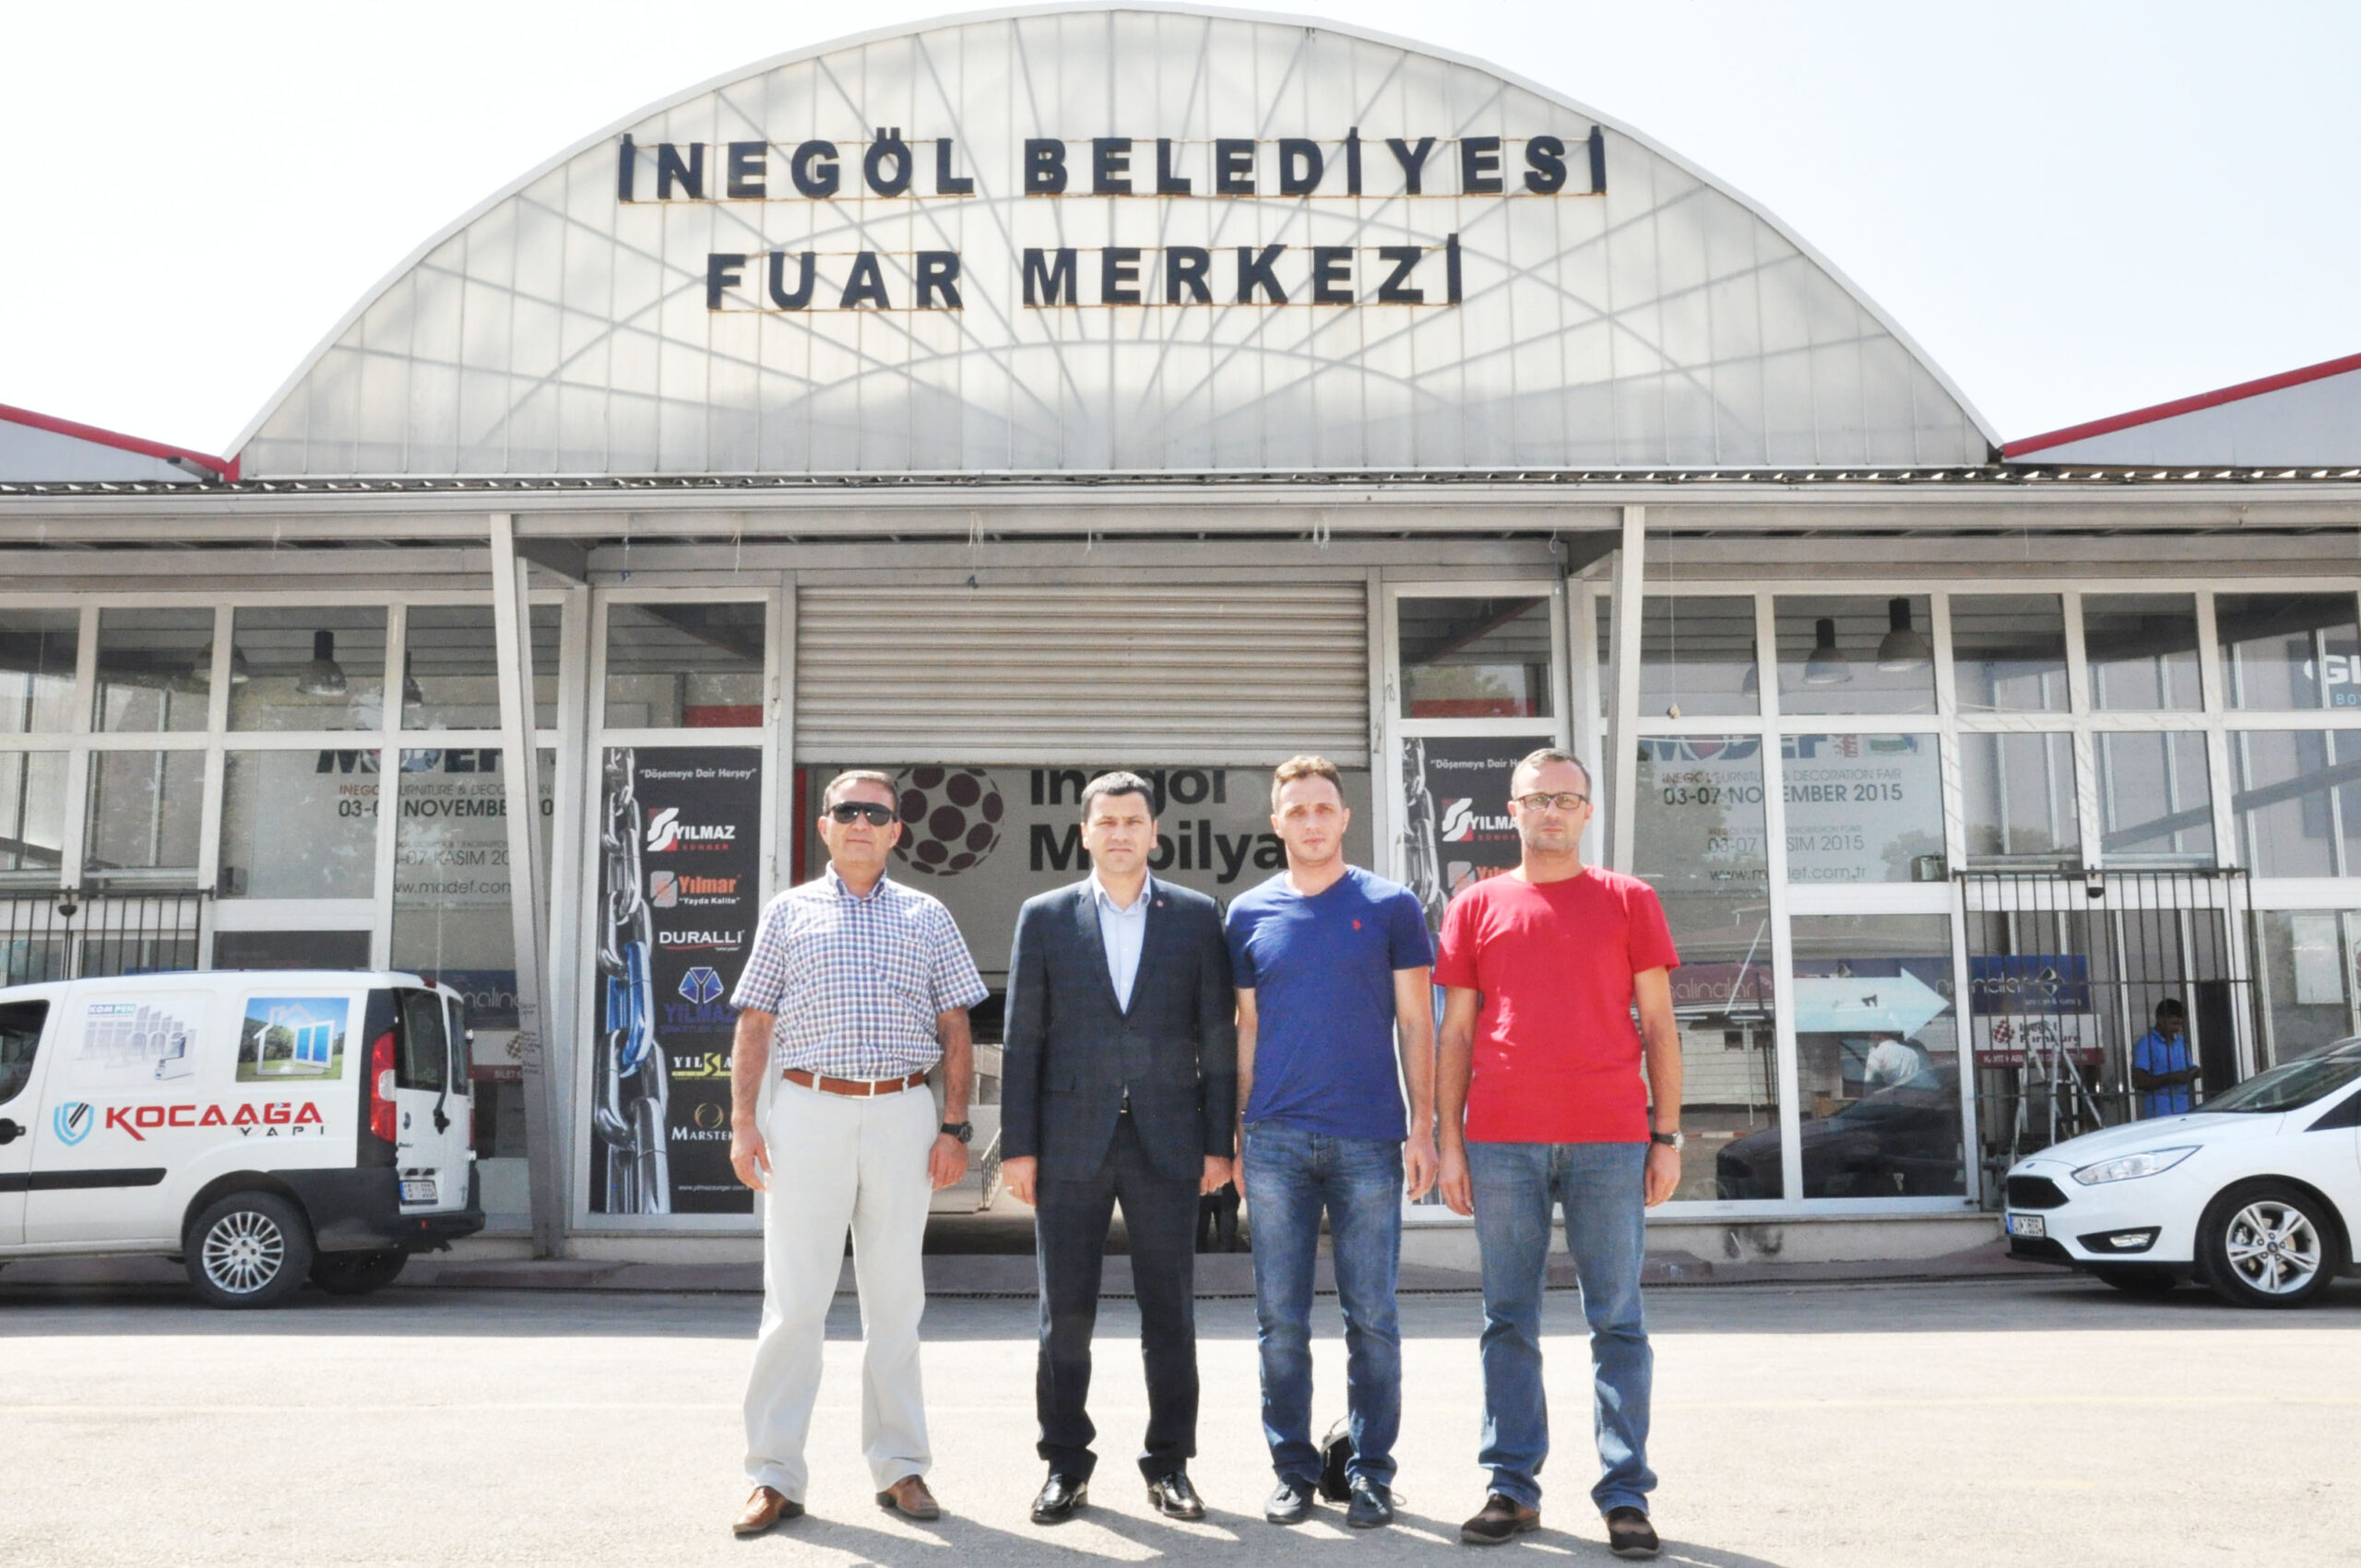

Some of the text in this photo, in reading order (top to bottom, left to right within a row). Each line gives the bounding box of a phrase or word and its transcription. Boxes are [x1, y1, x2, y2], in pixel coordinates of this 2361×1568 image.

[618, 125, 1607, 201] İNEGÖL BELEDİYESİ
[706, 232, 1462, 309] FUAR MERKEZİ
[2336, 694, 2361, 705] BO
[1877, 767, 1903, 780] FAIR
[1663, 783, 1904, 805] 03-07 NOEMBER 2015
[404, 799, 506, 817] NOVEMBE
[1471, 815, 1518, 830] YILMA
[676, 825, 736, 839] YILMAZ
[1029, 819, 1289, 885] Milya
[1786, 836, 1816, 853] SIM
[1821, 834, 1865, 851] 2015
[105, 1101, 324, 1142] KOCAAĞA
[240, 1125, 325, 1137] YAPI
[671, 1125, 734, 1141] MARSTE
